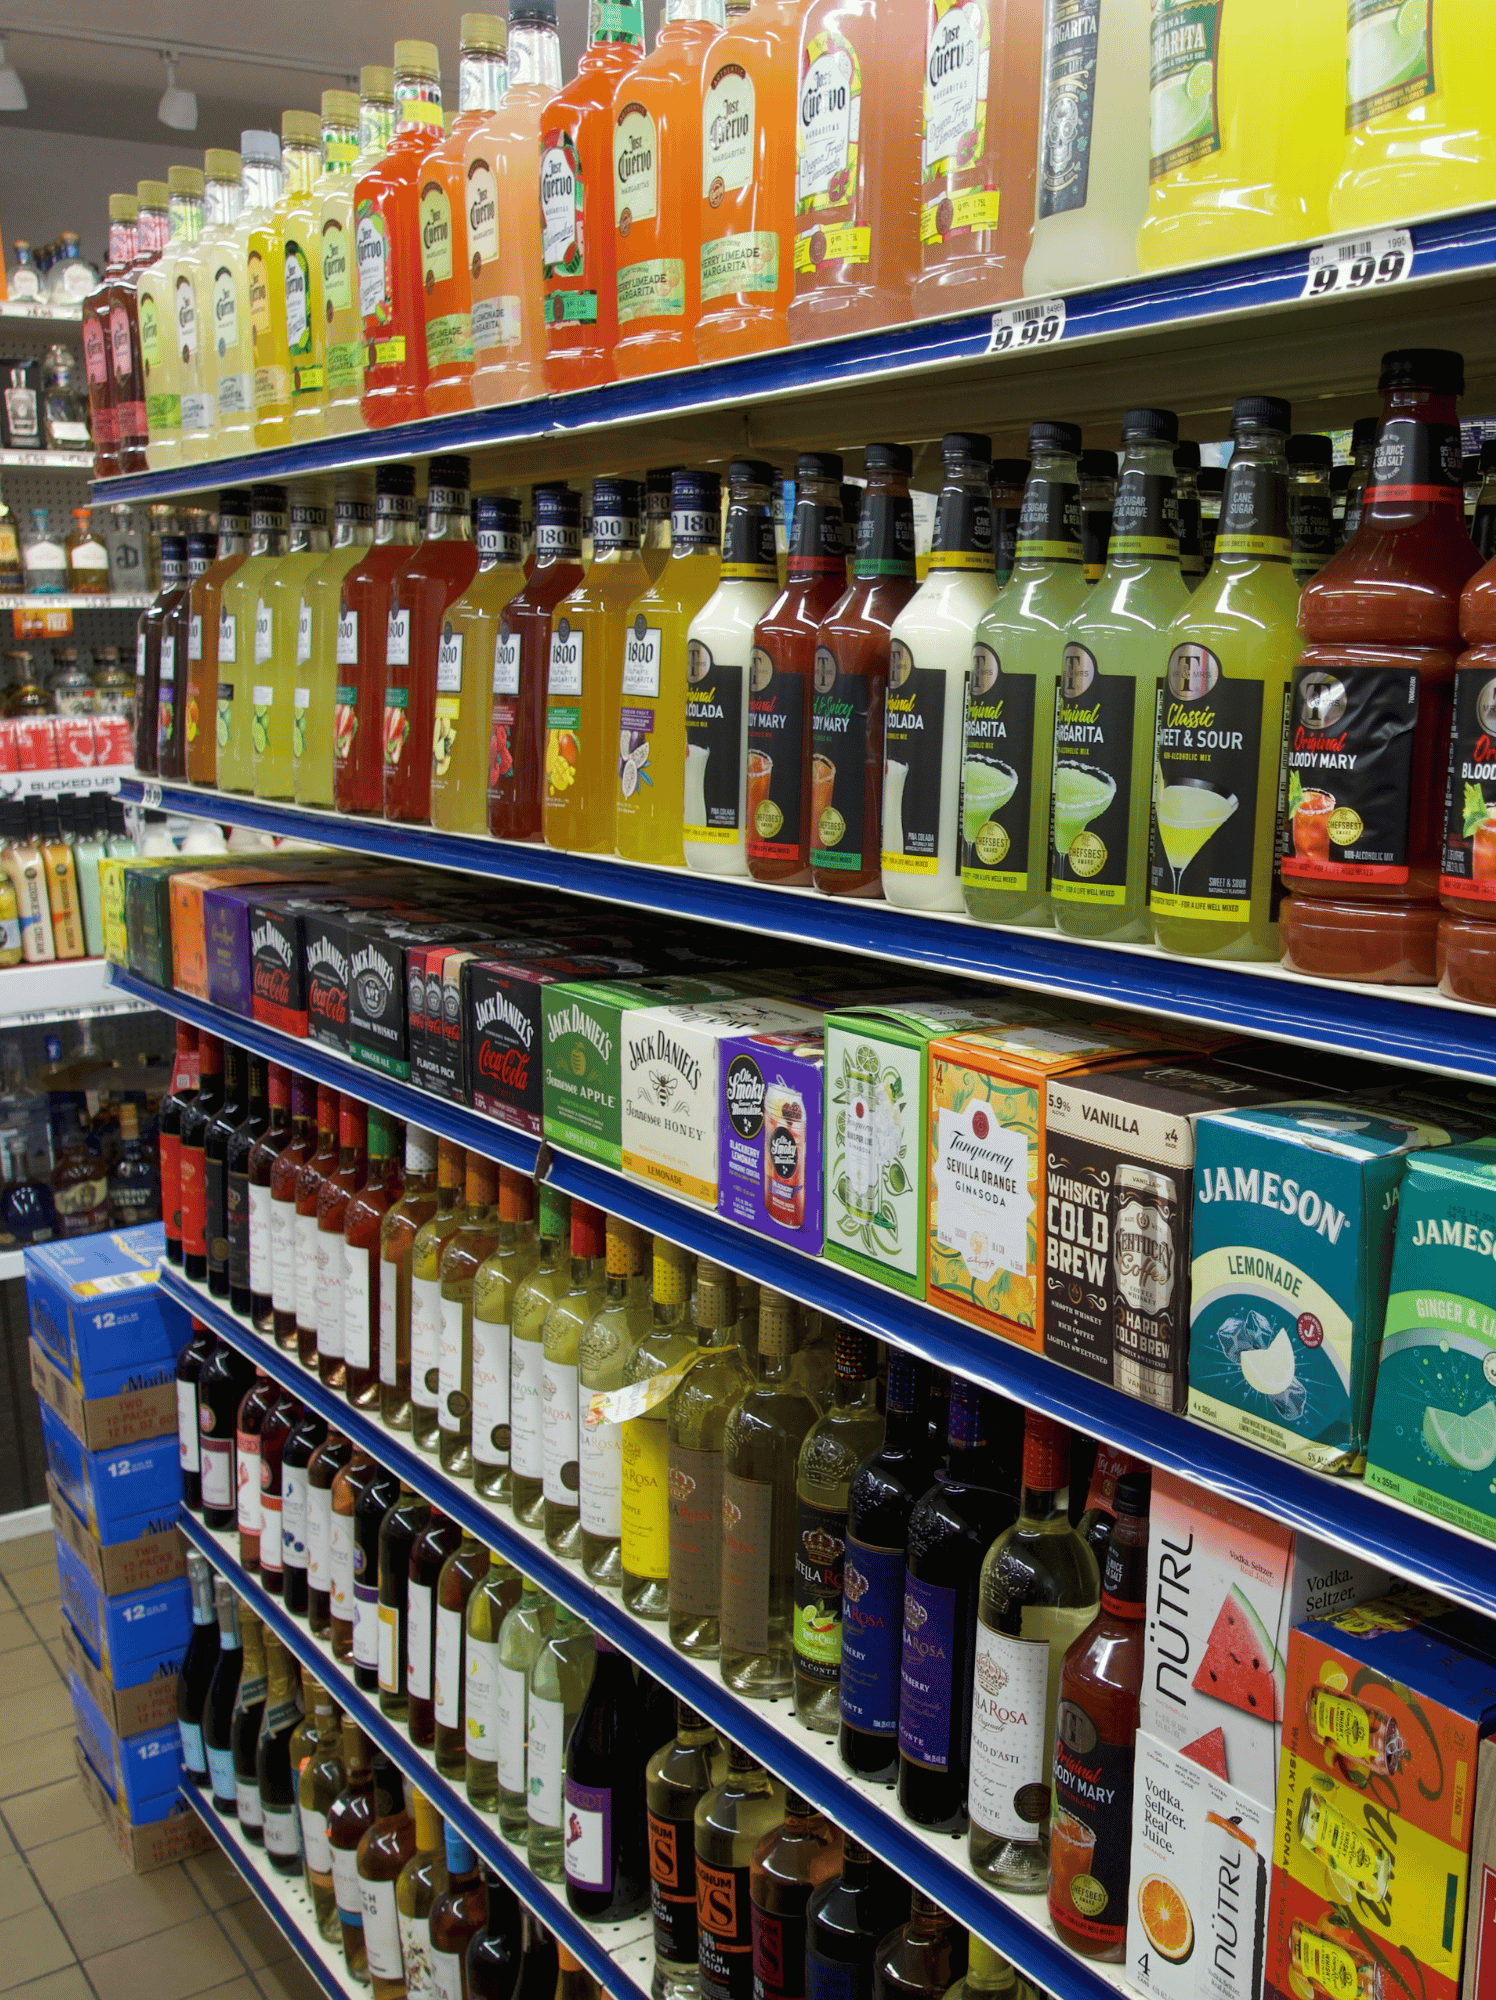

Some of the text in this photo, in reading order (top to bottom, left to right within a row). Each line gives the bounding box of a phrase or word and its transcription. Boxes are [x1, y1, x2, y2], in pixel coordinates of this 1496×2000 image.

[941, 24, 961, 49] Jose
[929, 40, 974, 88] Cuervo
[723, 99, 739, 118] Jose
[618, 150, 651, 183] Cuervo
[1311, 256, 1325, 265] 321
[1309, 250, 1406, 296] 9.99
[991, 315, 1060, 352] 9.99
[1027, 503, 1048, 513] SUGAR
[1124, 497, 1146, 507] SUGAR
[1230, 504, 1255, 514] SUGAR
[1233, 492, 1252, 503] CANE
[539, 528, 578, 545] 1800
[552, 644, 576, 664] 1800
[628, 642, 653, 663] 1800
[758, 714, 786, 729] MARY
[1167, 703, 1215, 728] Classic
[1294, 726, 1348, 753] Original
[1200, 753, 1211, 762] MIX
[1320, 754, 1357, 770] MARY
[31, 776, 115, 792] BUCKED UP
[1209, 877, 1225, 887] SWEET
[1232, 878, 1246, 888] SOUR
[1194, 901, 1204, 910] LIFE
[1205, 902, 1219, 911] WELL
[1221, 903, 1239, 913] MIXED
[252, 929, 266, 956] JACK
[307, 945, 322, 971] JACK
[351, 952, 367, 978] JACK
[476, 991, 534, 1052] JACK DANIEL'S
[548, 1003, 613, 1066] JACK DANIEL'S
[416, 1057, 455, 1079] FLAVORS PACK
[629, 1029, 702, 1091] JACK DANIEL'S
[739, 1068, 752, 1083] Ole
[935, 1063, 943, 1085] 4
[580, 1085, 615, 1109] APPLE
[727, 1073, 765, 1105] Smoky
[626, 1100, 662, 1128] Tennessee
[664, 1119, 704, 1142] HONEY
[1082, 1104, 1139, 1136] VANILLA
[1165, 1129, 1178, 1143] x4
[771, 1139, 796, 1157] Smoky
[950, 1130, 1014, 1172] Tanqueray
[647, 1165, 683, 1187] LEMONADE
[946, 1157, 1018, 1195] SEVILLA ORANGE
[1132, 1176, 1156, 1189] VANILLA
[1047, 1171, 1110, 1213] WHISKEY
[1198, 1166, 1346, 1246] JAMESON
[1047, 1195, 1109, 1254] COLD
[1047, 1235, 1107, 1288] BREW
[1115, 1229, 1172, 1270] KENTUCKY
[1118, 1252, 1167, 1288] Coffee
[1228, 1255, 1303, 1298] LEMONADE
[92, 1312, 116, 1330] 12
[1051, 1299, 1102, 1326] SMOOTH WHISKEY
[1126, 1310, 1158, 1338] HARD
[1058, 1320, 1095, 1342] RICH COFFEE
[1115, 1323, 1170, 1359] COLD BREW
[1046, 1333, 1108, 1365] LIGHTLY SWEETENED
[118, 1400, 143, 1411] TWO
[108, 1460, 130, 1477] 12
[629, 1469, 658, 1488] ROSA
[1229, 1550, 1275, 1579] Vodka. Seltzer.
[1306, 1569, 1354, 1592] Vodka.
[1305, 1585, 1356, 1613] Seltzer.
[123, 1604, 147, 1623] 12
[852, 1605, 885, 1629] ROSA
[913, 1637, 946, 1660] ROSA
[808, 1664, 838, 1676] CONTE
[138, 1743, 161, 1759] 12
[1056, 1740, 1103, 1784] Original
[1288, 1725, 1299, 1795] WHISKY
[1144, 1777, 1184, 1813] Vodka.
[1208, 1782, 1227, 1798] GLUTEN
[1211, 1791, 1224, 1802] FREE
[1144, 1794, 1187, 1831] Seltzer.
[1235, 1807, 1260, 1824] FLAVORS
[1236, 1801, 1260, 1818] NATURAL
[1144, 1809, 1168, 1836] Real
[1142, 1829, 1175, 1856] Juice.
[1137, 1953, 1151, 1977] 4
